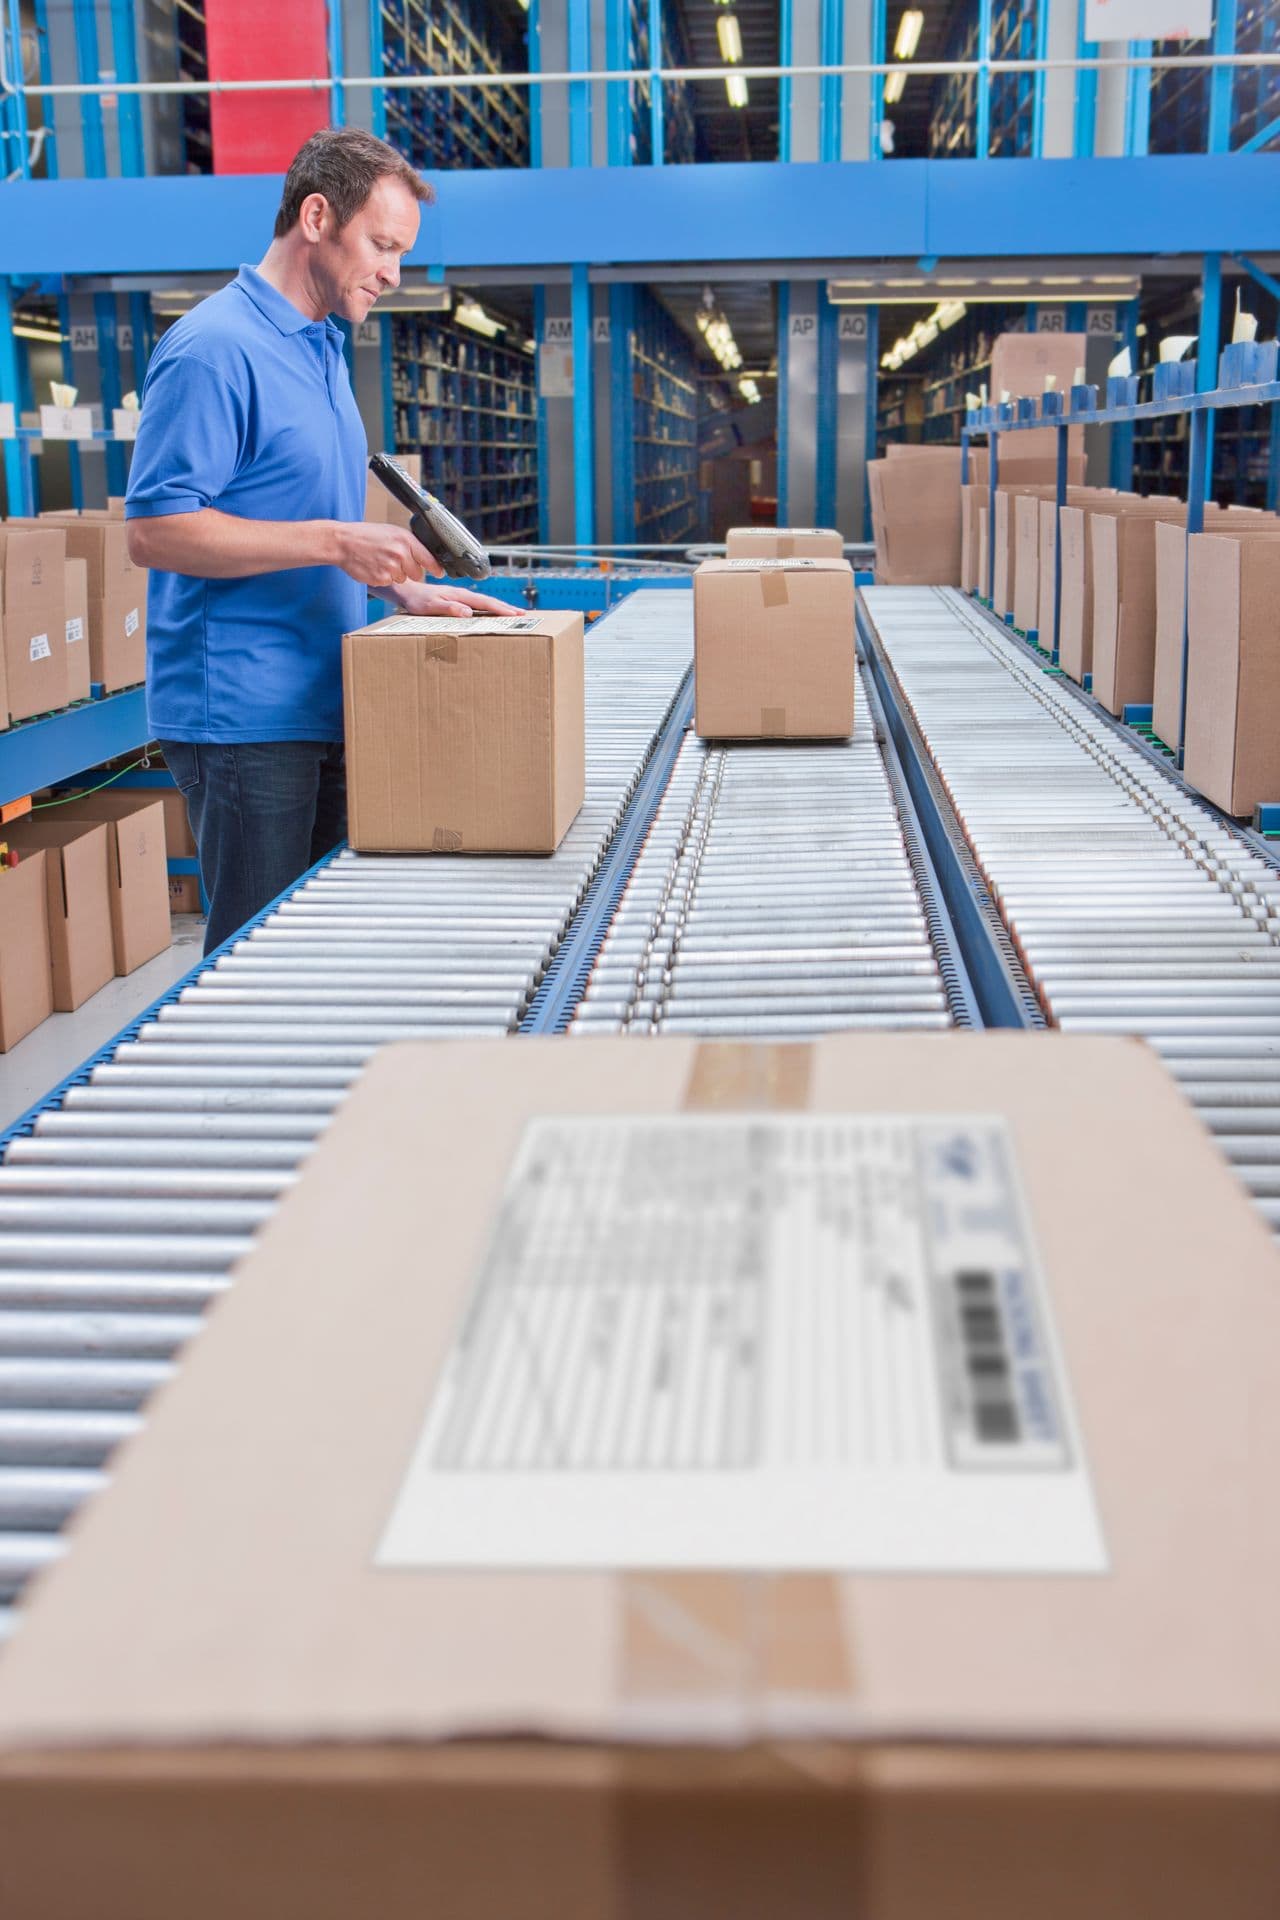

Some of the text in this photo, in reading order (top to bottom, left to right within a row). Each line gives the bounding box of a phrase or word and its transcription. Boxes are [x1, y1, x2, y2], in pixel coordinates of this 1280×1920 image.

[791, 317, 814, 336] AP
[842, 317, 866, 336] AQ
[1040, 313, 1063, 332] AR
[1091, 313, 1113, 332] AS
